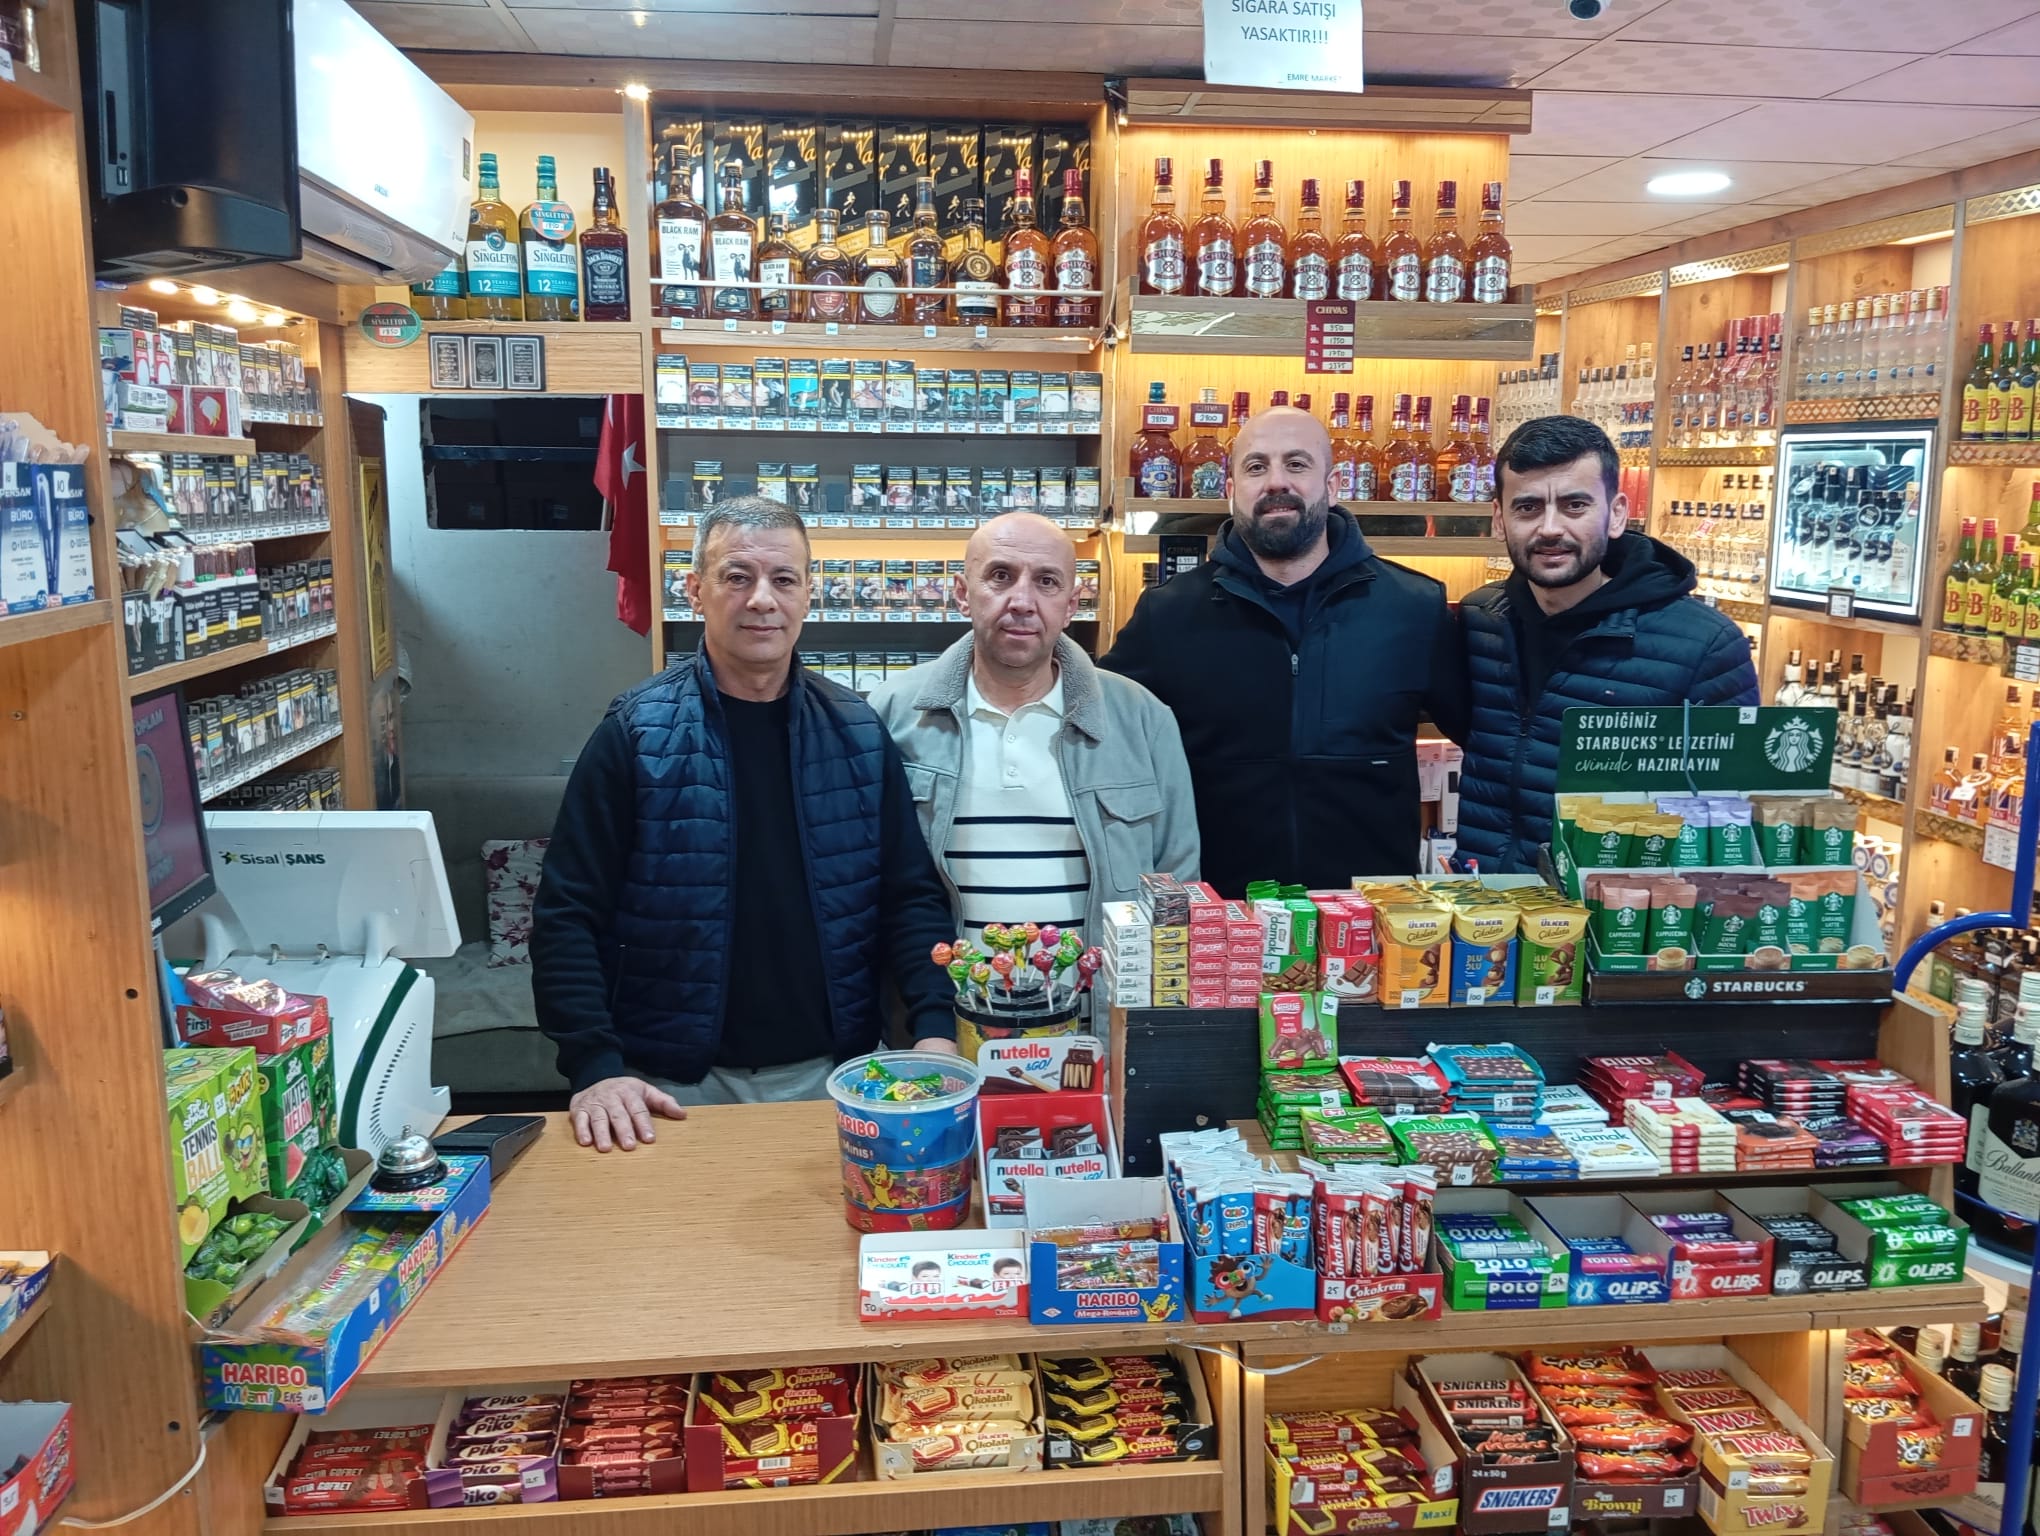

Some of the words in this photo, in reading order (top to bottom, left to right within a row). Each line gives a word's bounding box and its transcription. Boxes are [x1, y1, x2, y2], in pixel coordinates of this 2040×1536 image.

[1241, 26, 1329, 44] YASAKTIR!!!
[1287, 73, 1309, 82] EMRE
[662, 226, 682, 235] BLACK
[683, 227, 699, 236] RAM
[715, 237, 733, 245] BLACK
[474, 250, 518, 263] SINGLETON
[1011, 261, 1042, 270] CHIVAS
[1060, 261, 1091, 270] CHIVAS
[422, 279, 434, 291] 12
[478, 279, 491, 292] 12
[538, 279, 551, 291] 12
[1035, 306, 1042, 314] 12
[1084, 306, 1091, 314] 12
[1315, 306, 1348, 315] CHIVAS
[0, 487, 31, 498] PENSAN
[11, 509, 33, 522] BÜRO
[68, 509, 85, 521] BÜRO
[1578, 711, 1657, 729] SEVDİĞİNİZ
[1668, 732, 1735, 750] LEZETİNİ
[1575, 752, 1634, 773] evinizde
[1637, 757, 1720, 772] HAZIRLAYIN
[240, 853, 280, 865] Sisal
[285, 853, 326, 866] ŞANS
[1408, 920, 1437, 928] ÜLKER
[1541, 919, 1569, 927] ÜLKER
[1270, 916, 1283, 955] damak
[1713, 981, 1805, 992] STARBUCKS
[1469, 993, 1482, 1001] 100
[186, 1017, 210, 1031] First
[990, 1043, 1051, 1061] nutella
[283, 1077, 309, 1115] WATER
[1497, 1098, 1511, 1108] 75
[285, 1101, 312, 1140] MELON
[182, 1119, 218, 1160] TENNIS
[1570, 1130, 1631, 1141] damak
[186, 1143, 224, 1193] BALL
[996, 1163, 1045, 1177] nutella
[1055, 1159, 1101, 1176] nutella
[1400, 1202, 1418, 1273] Çokokrem
[400, 1231, 436, 1280] HARIBO
[1474, 1258, 1529, 1272] POLO
[1327, 1286, 1338, 1295] 25
[1345, 1282, 1406, 1303] Çokokrem
[1489, 1283, 1540, 1295] POLO
[1077, 1293, 1139, 1308] HARIBO
[951, 1355, 999, 1372] Çikolatalı
[223, 1364, 306, 1386] HARIBO
[1442, 1380, 1507, 1391] SNICKERS
[489, 1394, 527, 1407] Piko
[962, 1394, 1013, 1410] Çikolatalı
[1457, 1400, 1522, 1409] SNICKERS
[474, 1420, 514, 1436] Piko
[468, 1444, 508, 1457] Piko
[461, 1464, 502, 1476] Piko
[317, 1482, 352, 1491] GOFRET
[1478, 1487, 1558, 1510] SNICKERS
[1666, 1494, 1678, 1504] 25
[1583, 1498, 1642, 1515] Browni
[1421, 1509, 1452, 1521] Maxi
